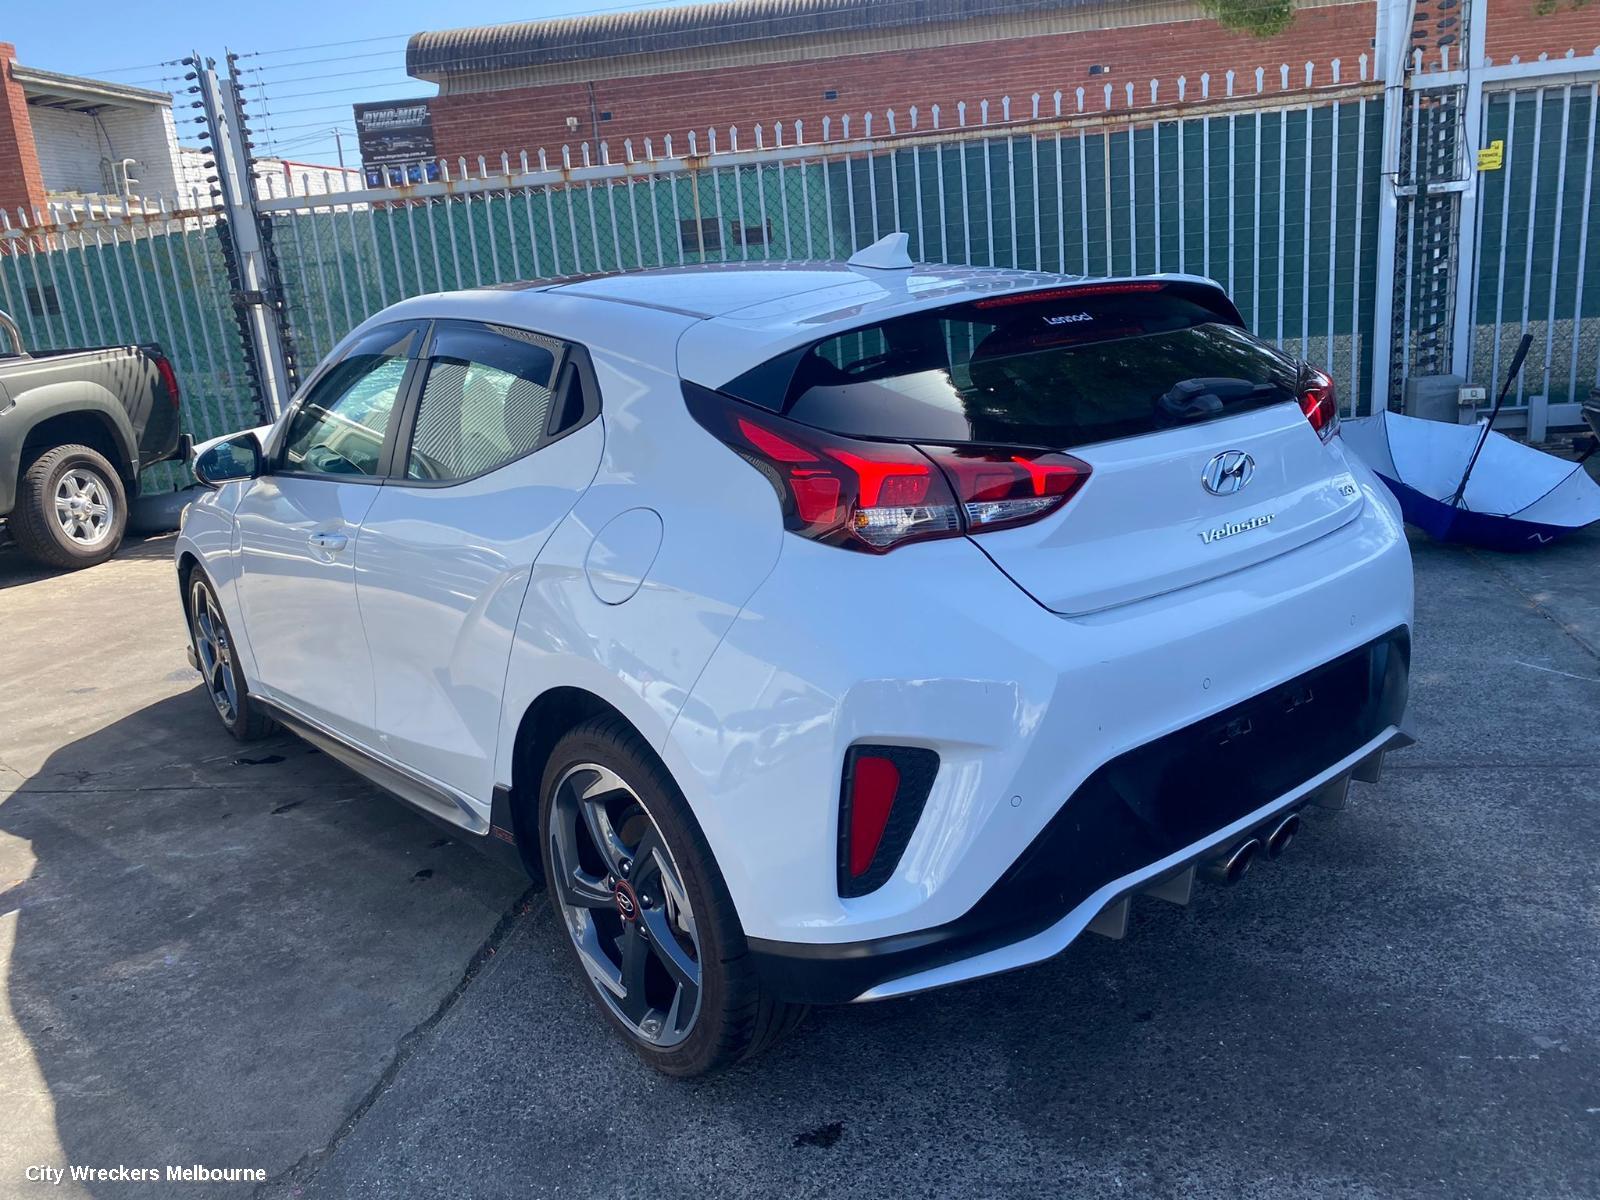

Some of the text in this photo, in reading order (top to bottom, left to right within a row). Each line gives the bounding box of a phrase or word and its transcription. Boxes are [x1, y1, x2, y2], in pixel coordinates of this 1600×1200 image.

[364, 106, 426, 122] DYNO-MITE
[366, 119, 422, 129] PERFORMANCE
[1199, 513, 1275, 544] Veloster
